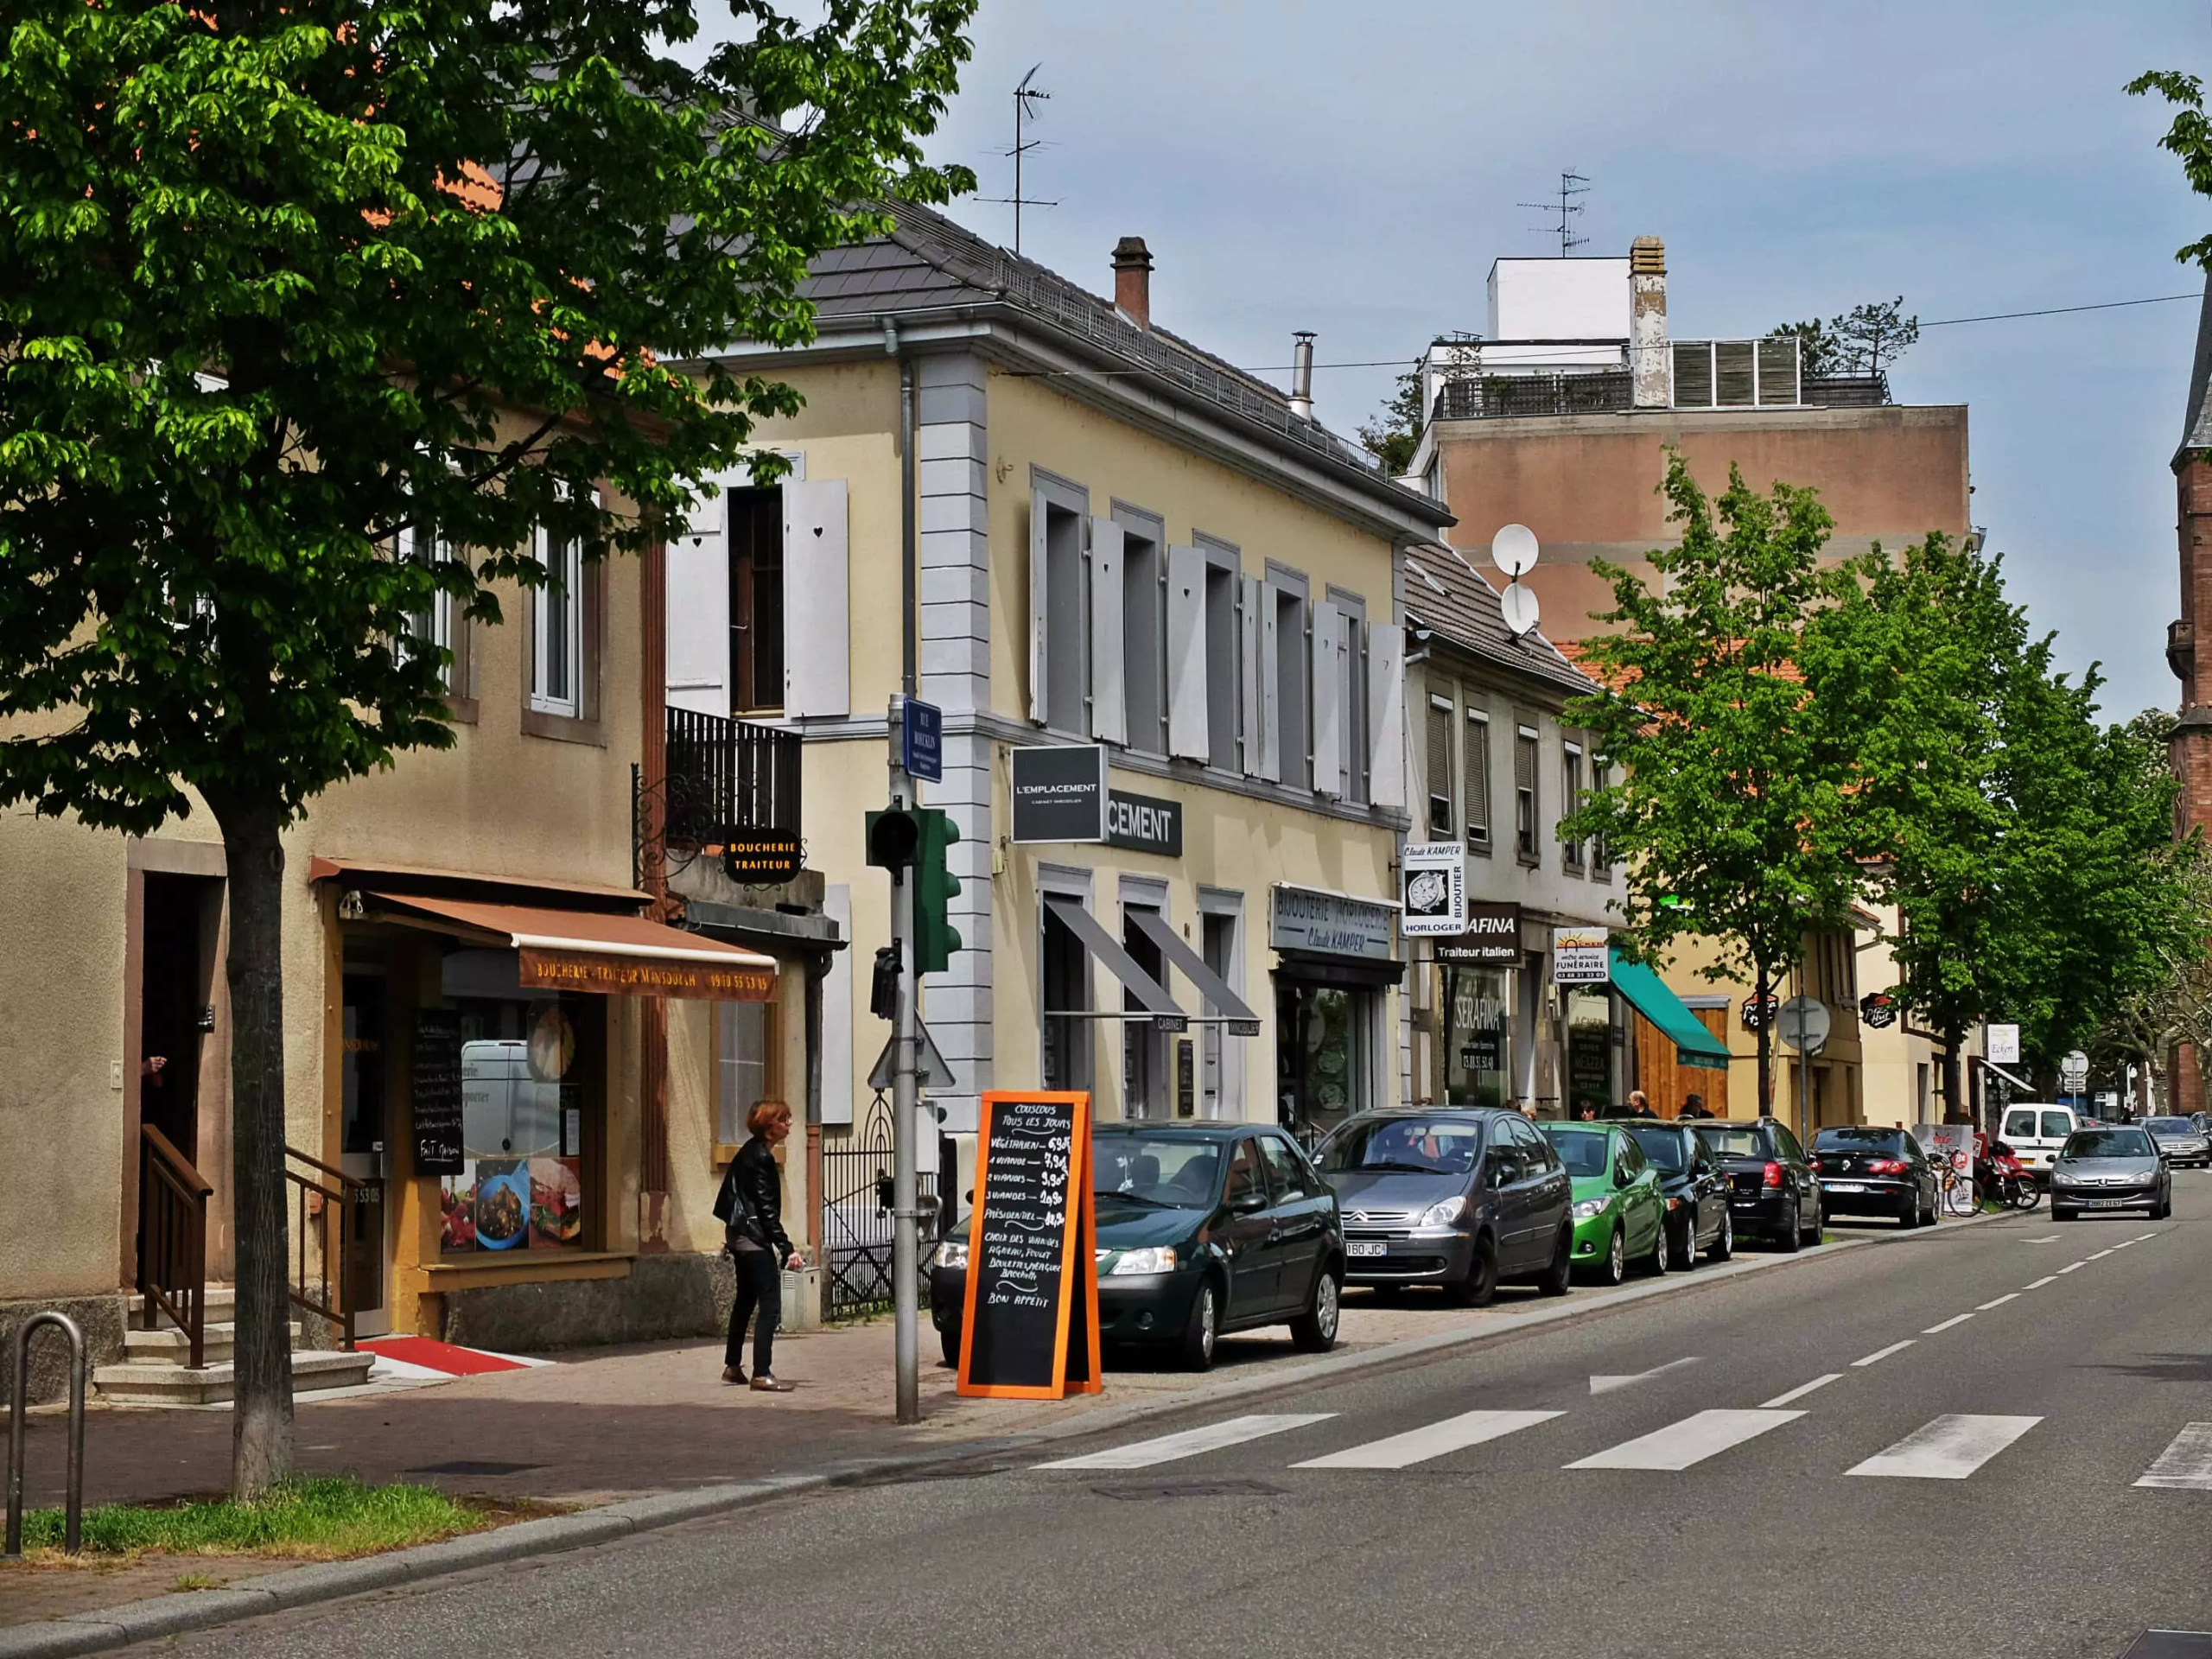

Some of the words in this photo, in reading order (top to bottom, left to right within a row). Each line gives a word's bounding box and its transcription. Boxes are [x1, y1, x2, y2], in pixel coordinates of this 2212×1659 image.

[1016, 784, 1097, 794] L'EMPLACEMENT
[730, 842, 795, 853] BOUCHERIE
[1427, 846, 1461, 855] KAMPER
[734, 860, 791, 870] TRAITEUR
[1453, 866, 1462, 918] BIJOUTIER
[1277, 892, 1329, 921] BIJOUTERIE
[1332, 930, 1364, 952] KAMPER
[1438, 947, 1480, 957] Traiteur
[1482, 946, 1515, 957] italien
[1556, 960, 1605, 969] FUNÉRAIRE
[1456, 995, 1500, 1031] SERAFINA
[1158, 1018, 1183, 1031] CABINET
[1014, 1104, 1056, 1116] COUSCOUS
[1002, 1115, 1022, 1127] TOUS
[1026, 1116, 1039, 1127] LES
[1043, 1117, 1071, 1130] JOURS
[996, 1156, 1027, 1166] VIANDE
[993, 1173, 1026, 1184] VIANDES
[992, 1192, 1027, 1201] VIANDES
[984, 1232, 1007, 1243] CHOIX
[1009, 1234, 1024, 1244] DES
[1348, 1244, 1364, 1255] 160
[1368, 1244, 1381, 1255] JC
[987, 1292, 1009, 1304] BON
